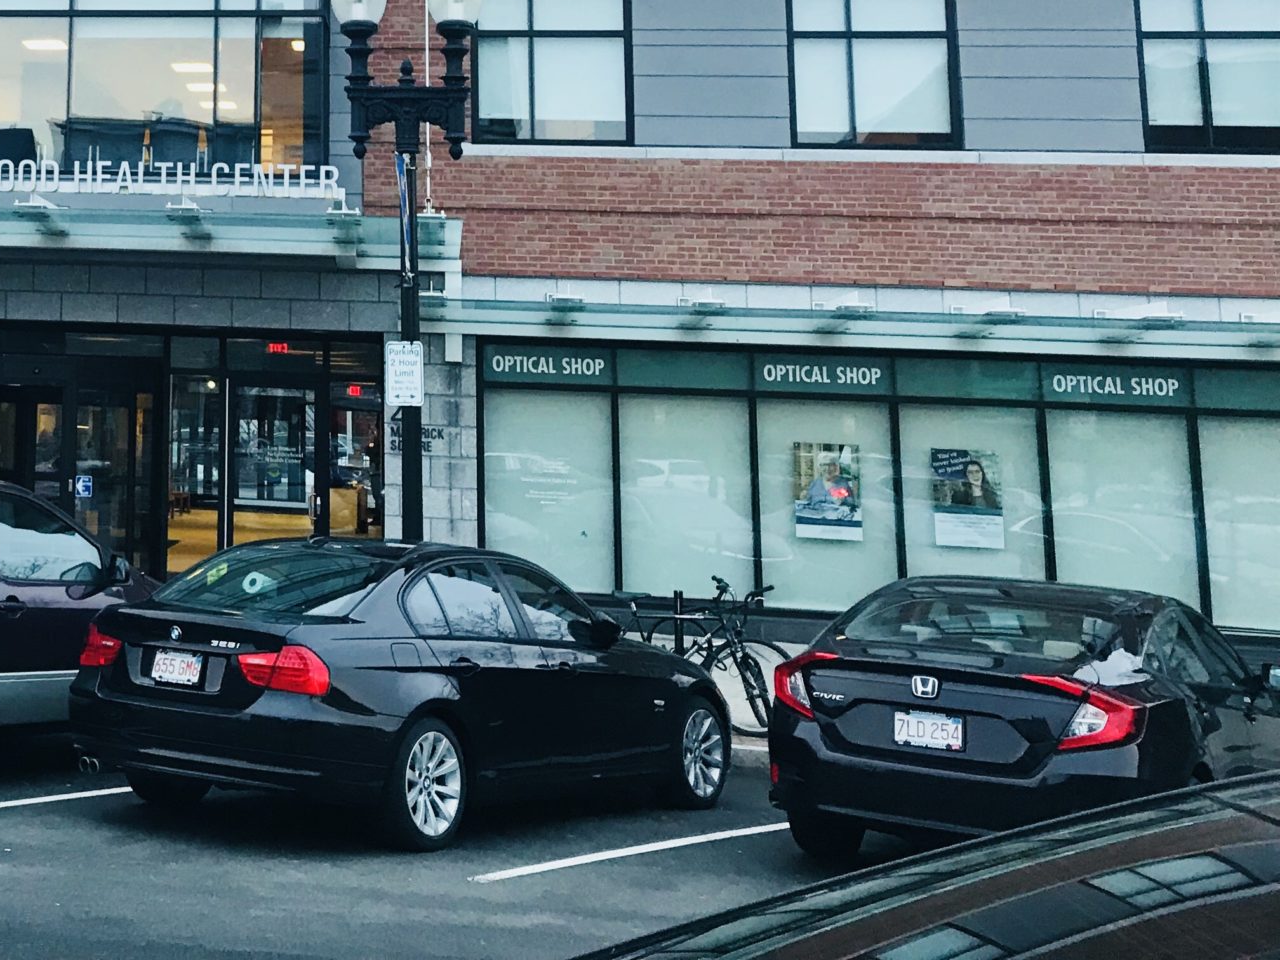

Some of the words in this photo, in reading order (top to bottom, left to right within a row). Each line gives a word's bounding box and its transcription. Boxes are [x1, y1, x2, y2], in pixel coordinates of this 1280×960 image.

[73, 160, 197, 196] HEALTH
[210, 162, 340, 199] CENTER
[388, 347, 420, 357] Parking
[390, 359, 396, 367] 2
[399, 359, 418, 367] Hour
[492, 355, 557, 374] OPTICAL
[561, 357, 605, 376] SHOP
[394, 369, 414, 377] Limit
[763, 364, 831, 383] OPTICAL
[836, 366, 881, 385] SHOP
[1052, 374, 1125, 395] OPTICAL
[1130, 377, 1179, 396] SHOP
[390, 426, 445, 440] MRICK
[390, 439, 432, 453] SRE
[154, 657, 176, 675] 655
[812, 691, 845, 701] CIVIC
[896, 717, 926, 739] 7LD
[930, 721, 960, 742] 254
